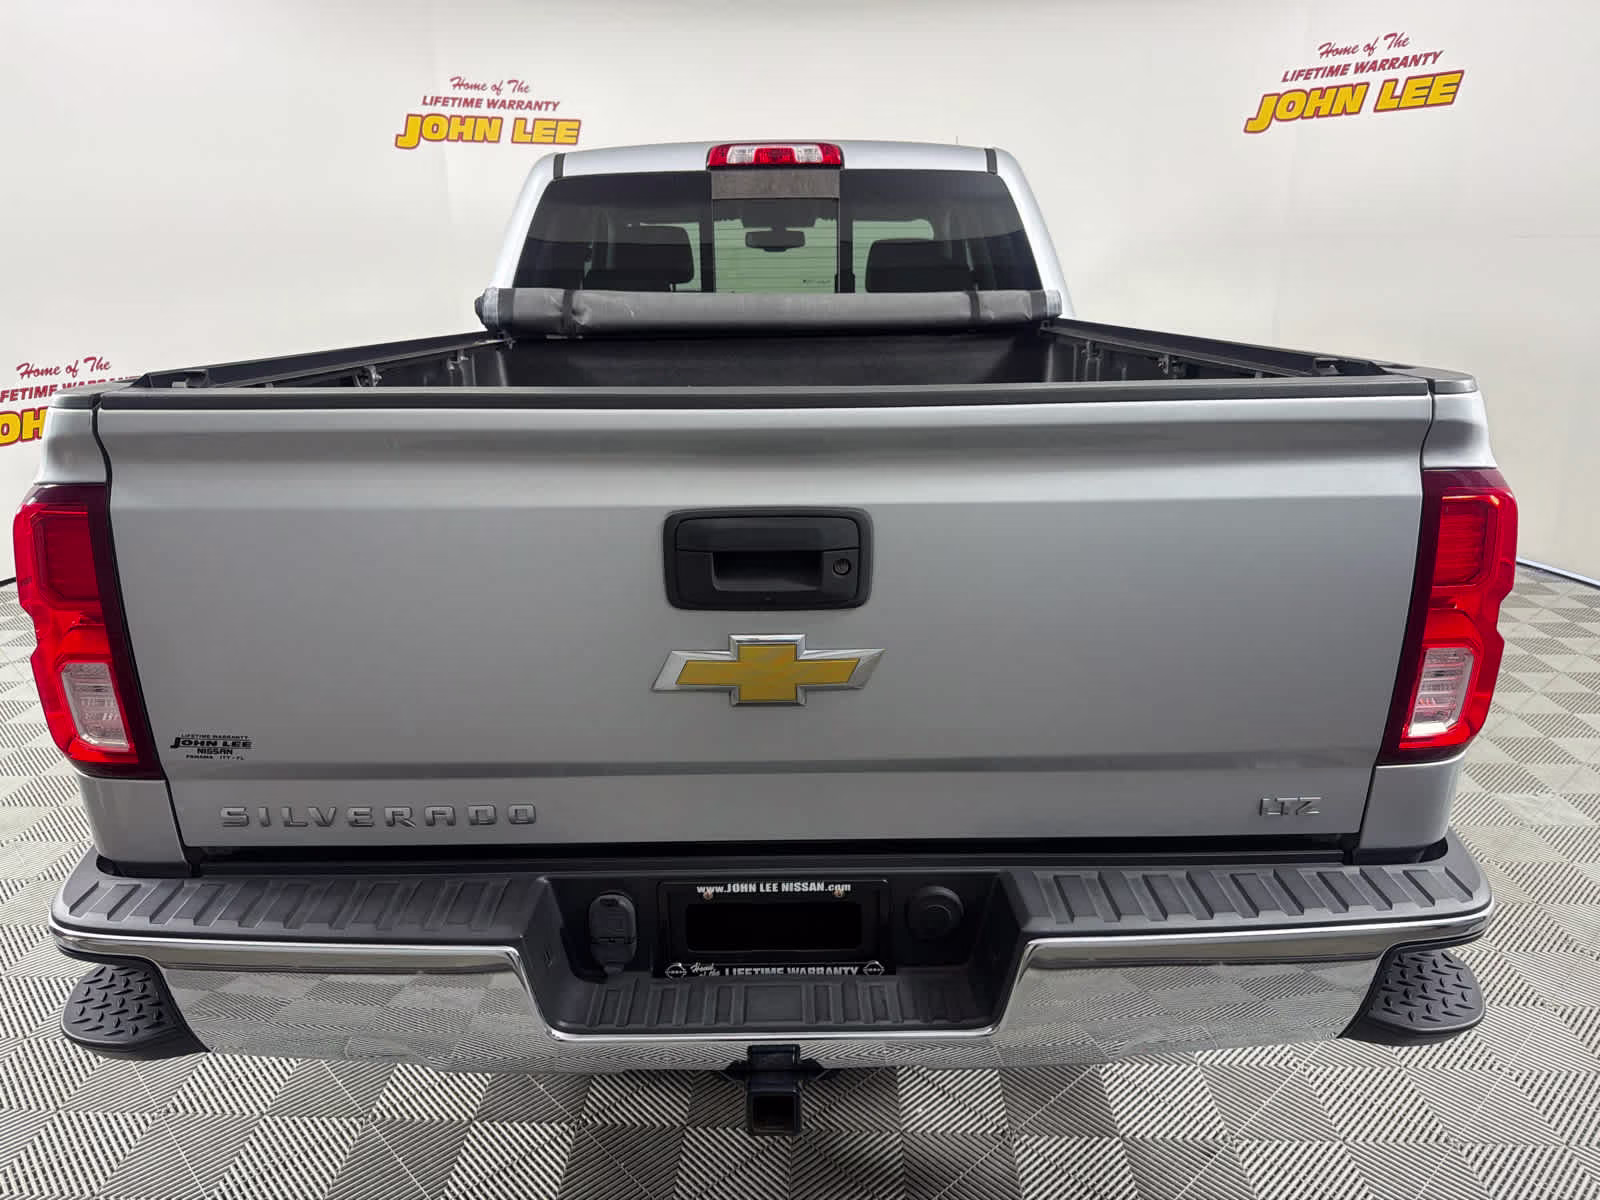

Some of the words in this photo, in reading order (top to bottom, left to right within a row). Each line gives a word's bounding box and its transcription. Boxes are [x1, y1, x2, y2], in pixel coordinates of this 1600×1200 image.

[1318, 41, 1359, 59] Home
[1362, 36, 1379, 57] of
[1383, 32, 1410, 50] The
[1281, 63, 1351, 83] LIFETIME
[1353, 50, 1444, 75] WARRANTY
[449, 76, 488, 91] Home
[490, 80, 504, 96] of
[507, 79, 531, 94] The
[421, 95, 483, 109] LIFETIME
[486, 98, 560, 112] WARRANTY
[1243, 82, 1370, 133] JOHN
[1374, 69, 1464, 112] LEE
[395, 113, 503, 150] JOHN
[511, 118, 581, 145] LEE
[16, 362, 62, 379] Home
[65, 359, 79, 378] of
[83, 356, 111, 372] The
[0, 384, 58, 403] FETIME
[0, 406, 49, 447] OH
[170, 737, 218, 748] JOHN
[220, 804, 537, 828] SILVERADO
[1259, 796, 1322, 817] LTZ
[759, 883, 779, 893] LEE
[725, 967, 785, 976] LIFETIME
[786, 966, 859, 975] WARRANTY
